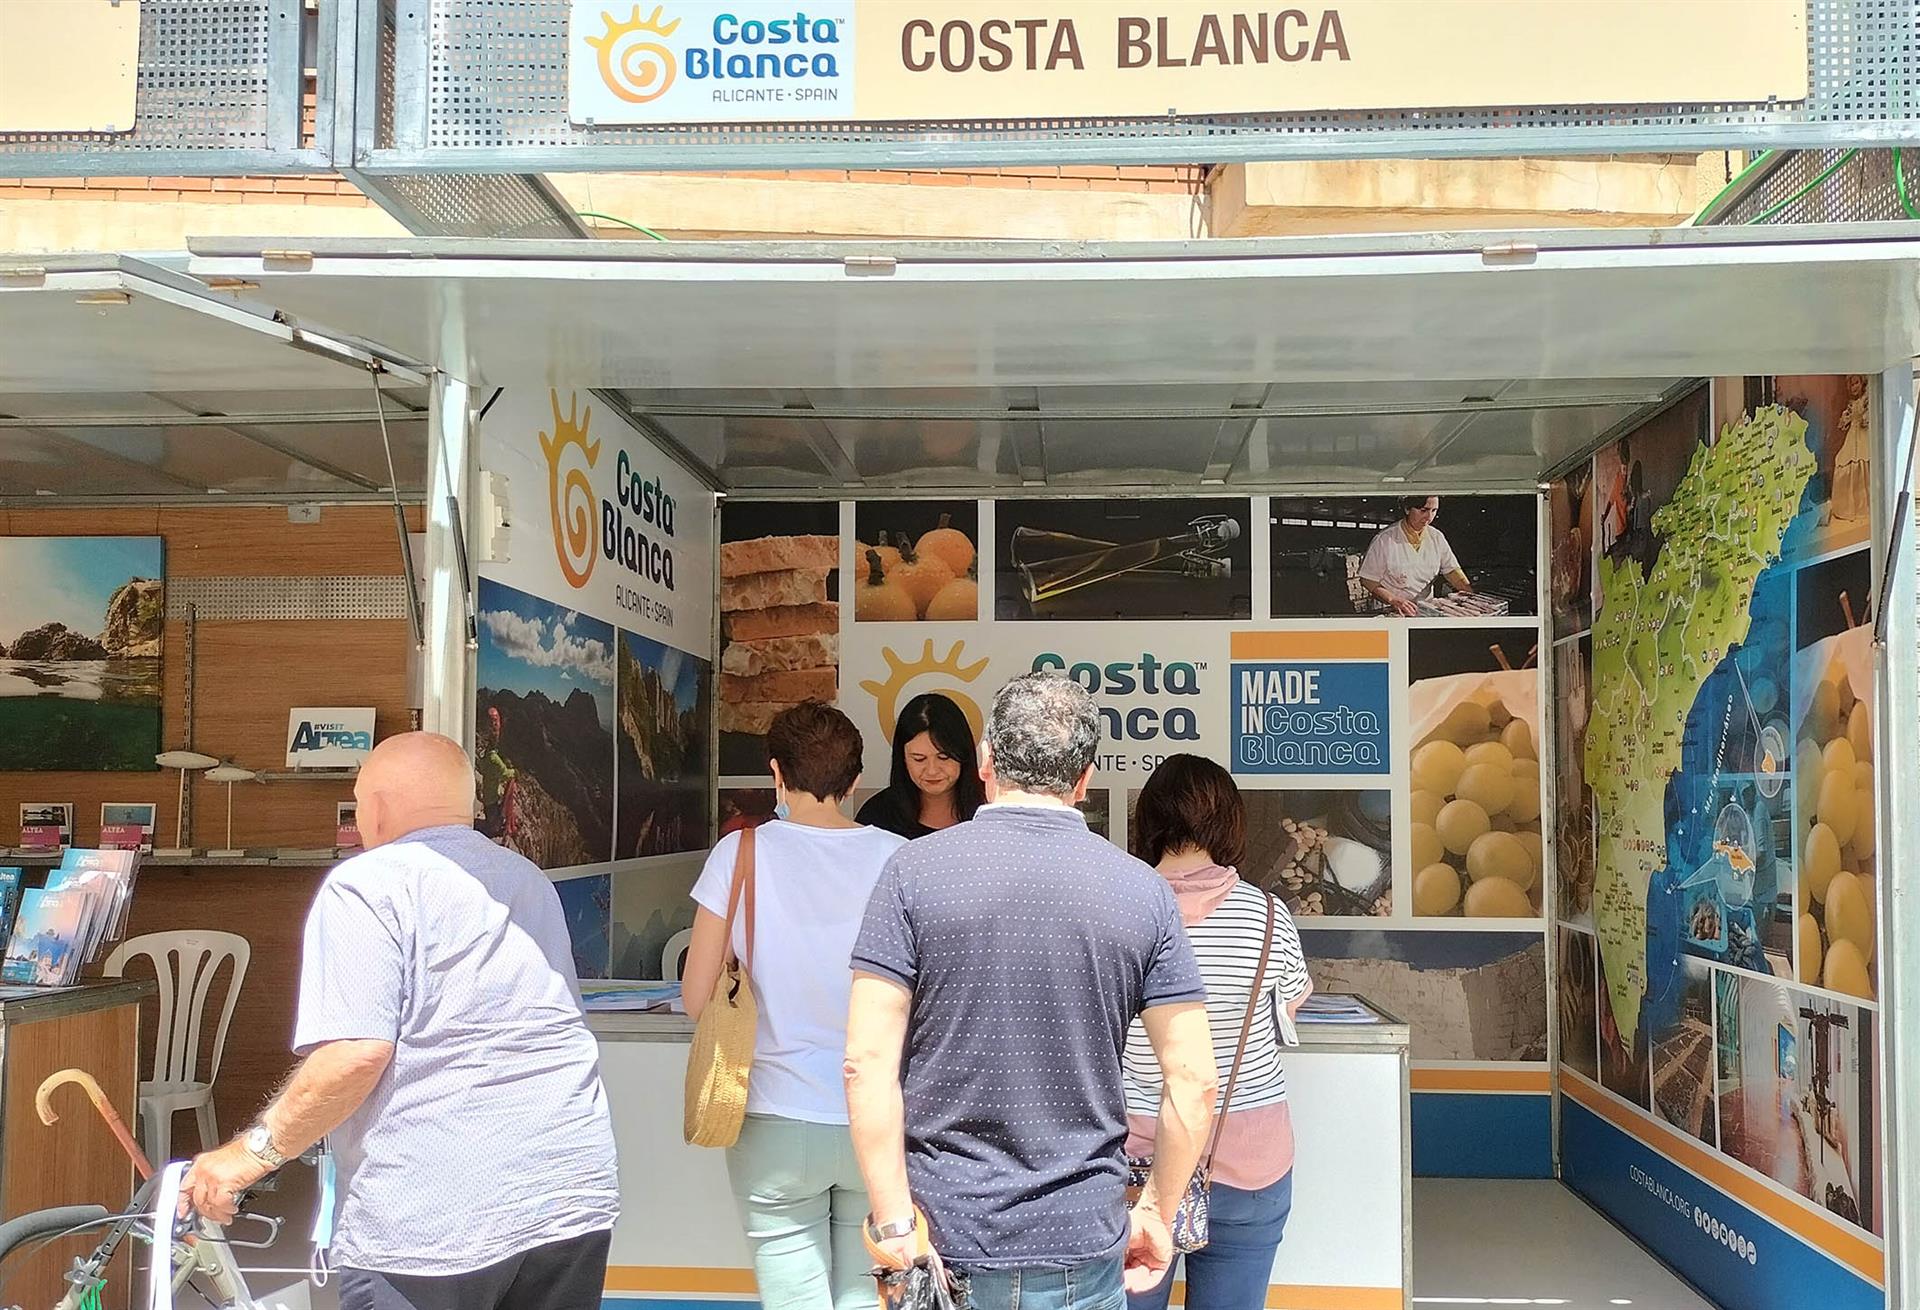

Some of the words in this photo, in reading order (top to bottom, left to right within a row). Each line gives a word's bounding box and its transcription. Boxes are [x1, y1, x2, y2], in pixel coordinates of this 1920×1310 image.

[713, 12, 840, 45] Costa
[901, 19, 1085, 73] COSTA
[1117, 9, 1351, 69] BLANCA
[685, 48, 840, 80] Blanca
[712, 89, 784, 102] ALICANTE
[795, 88, 838, 101] SPAIN
[616, 449, 675, 538] Costa
[602, 498, 675, 592] Blanca
[616, 584, 651, 619] ALICANTE
[1241, 670, 1321, 705] MADE
[1098, 707, 1201, 741] nca
[1241, 706, 1264, 734] IN
[1264, 705, 1381, 736] Costa
[1240, 735, 1381, 766] Blanca
[22, 826, 44, 834] ALTEA
[102, 826, 126, 834] ALTEA
[1629, 1164, 1691, 1219] COSTABLANCA.ORG
